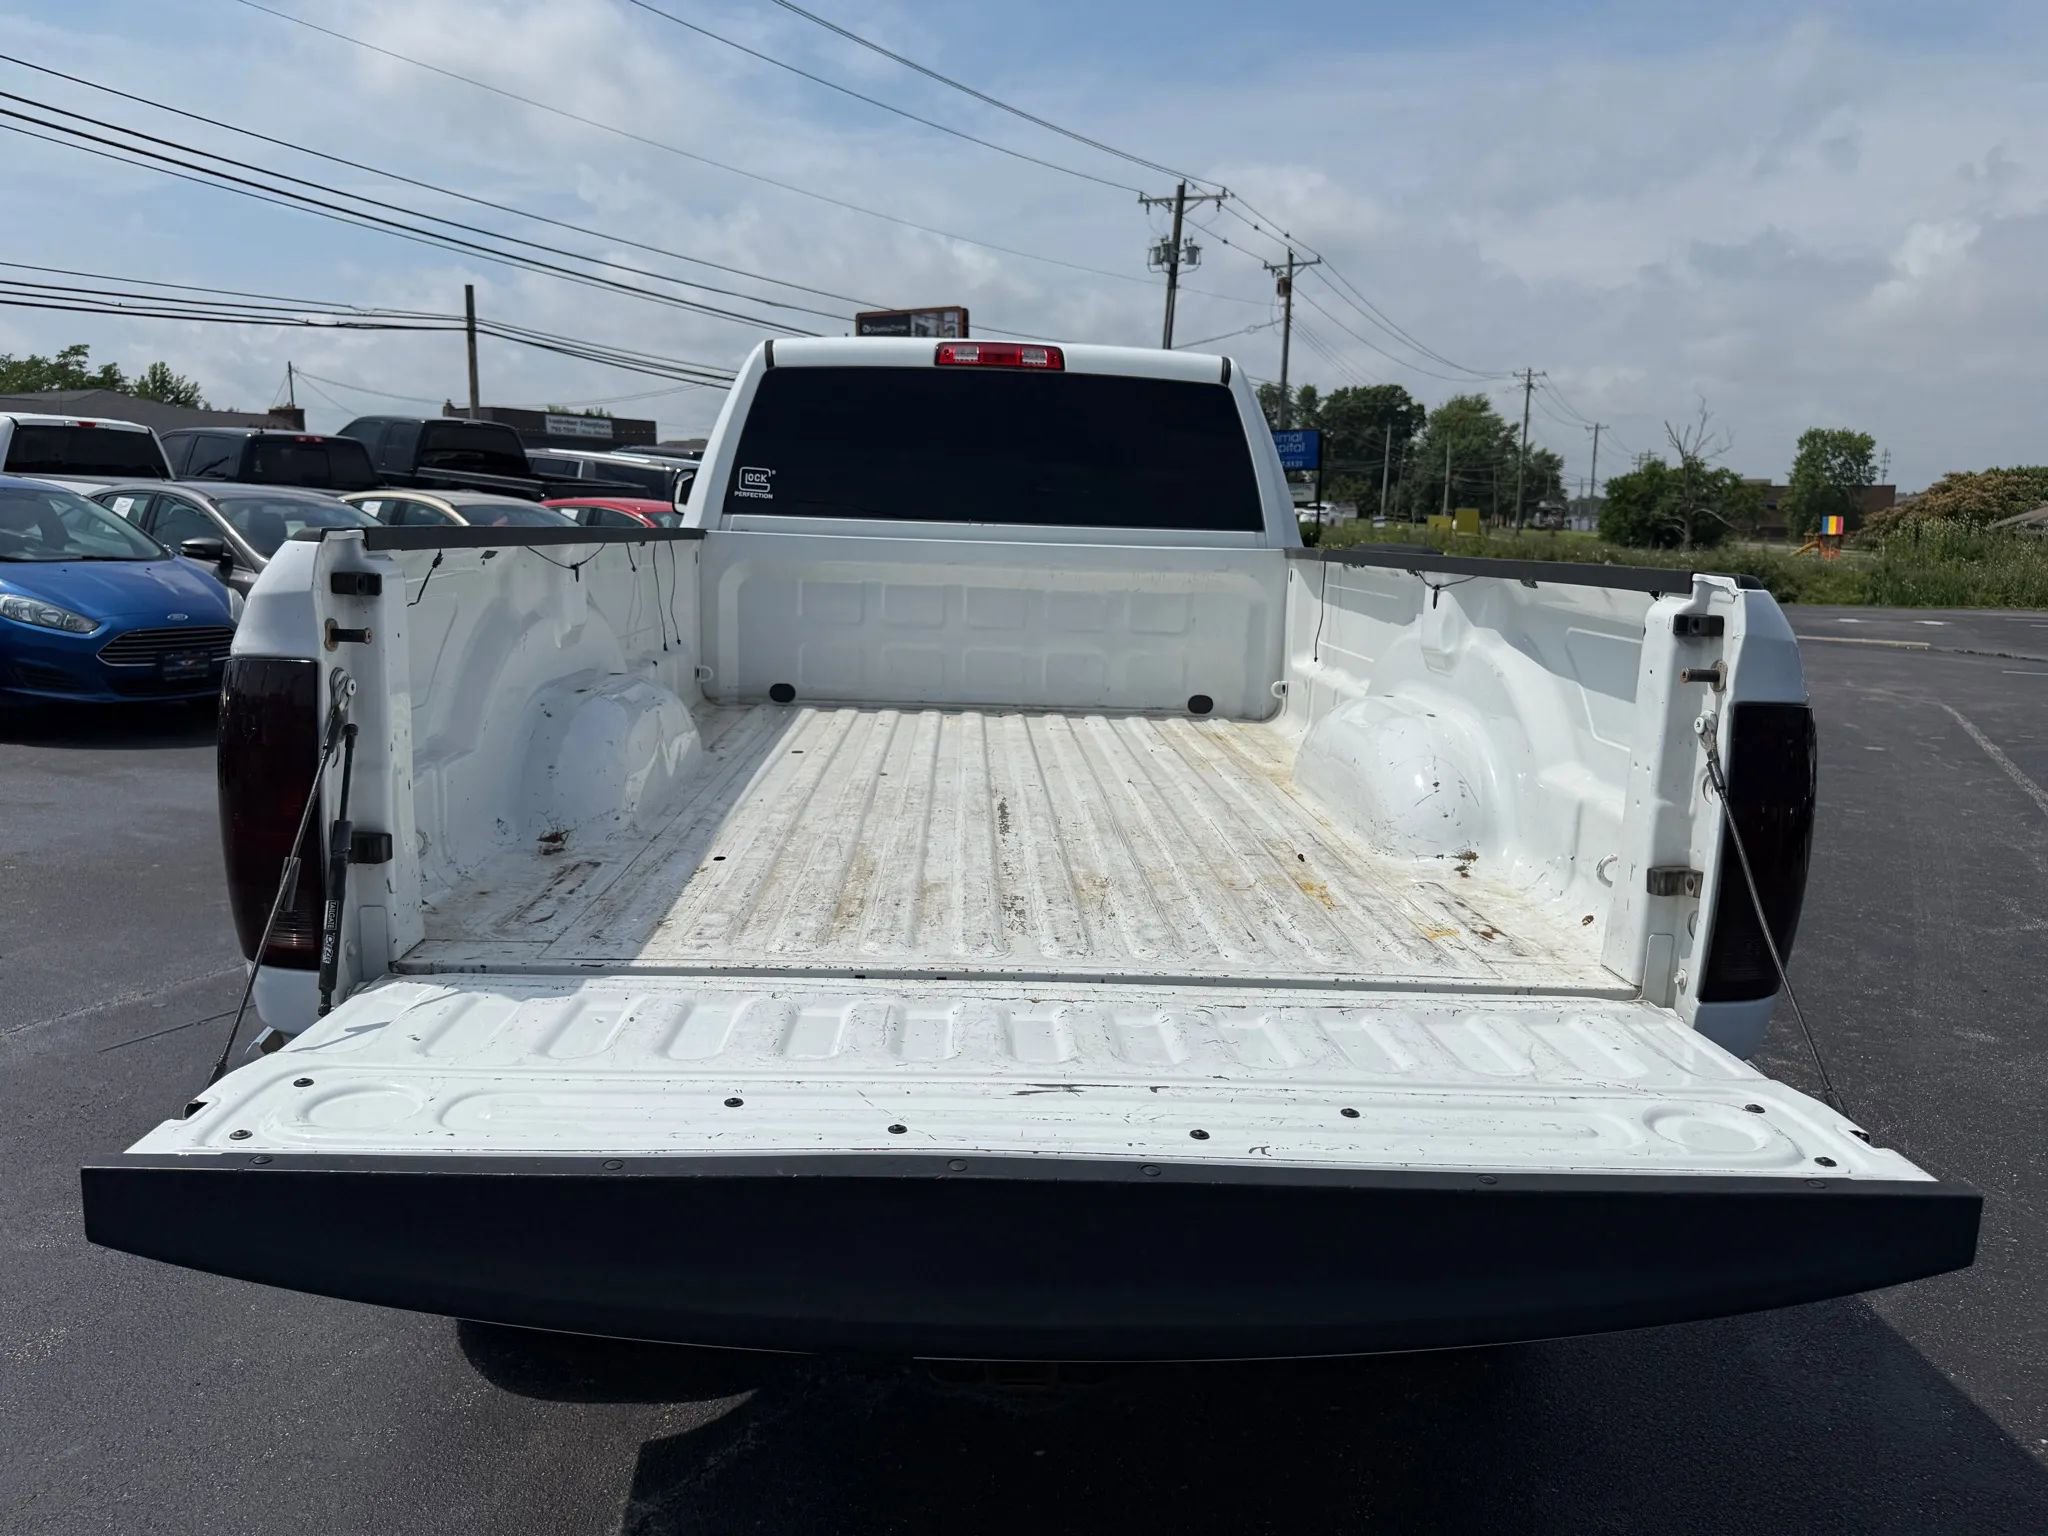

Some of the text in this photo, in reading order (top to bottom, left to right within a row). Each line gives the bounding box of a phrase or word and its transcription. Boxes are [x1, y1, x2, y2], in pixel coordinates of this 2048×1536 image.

[1277, 442, 1305, 453] pital
[734, 490, 774, 499] PERFECTION
[327, 900, 337, 929] TAILGATE
